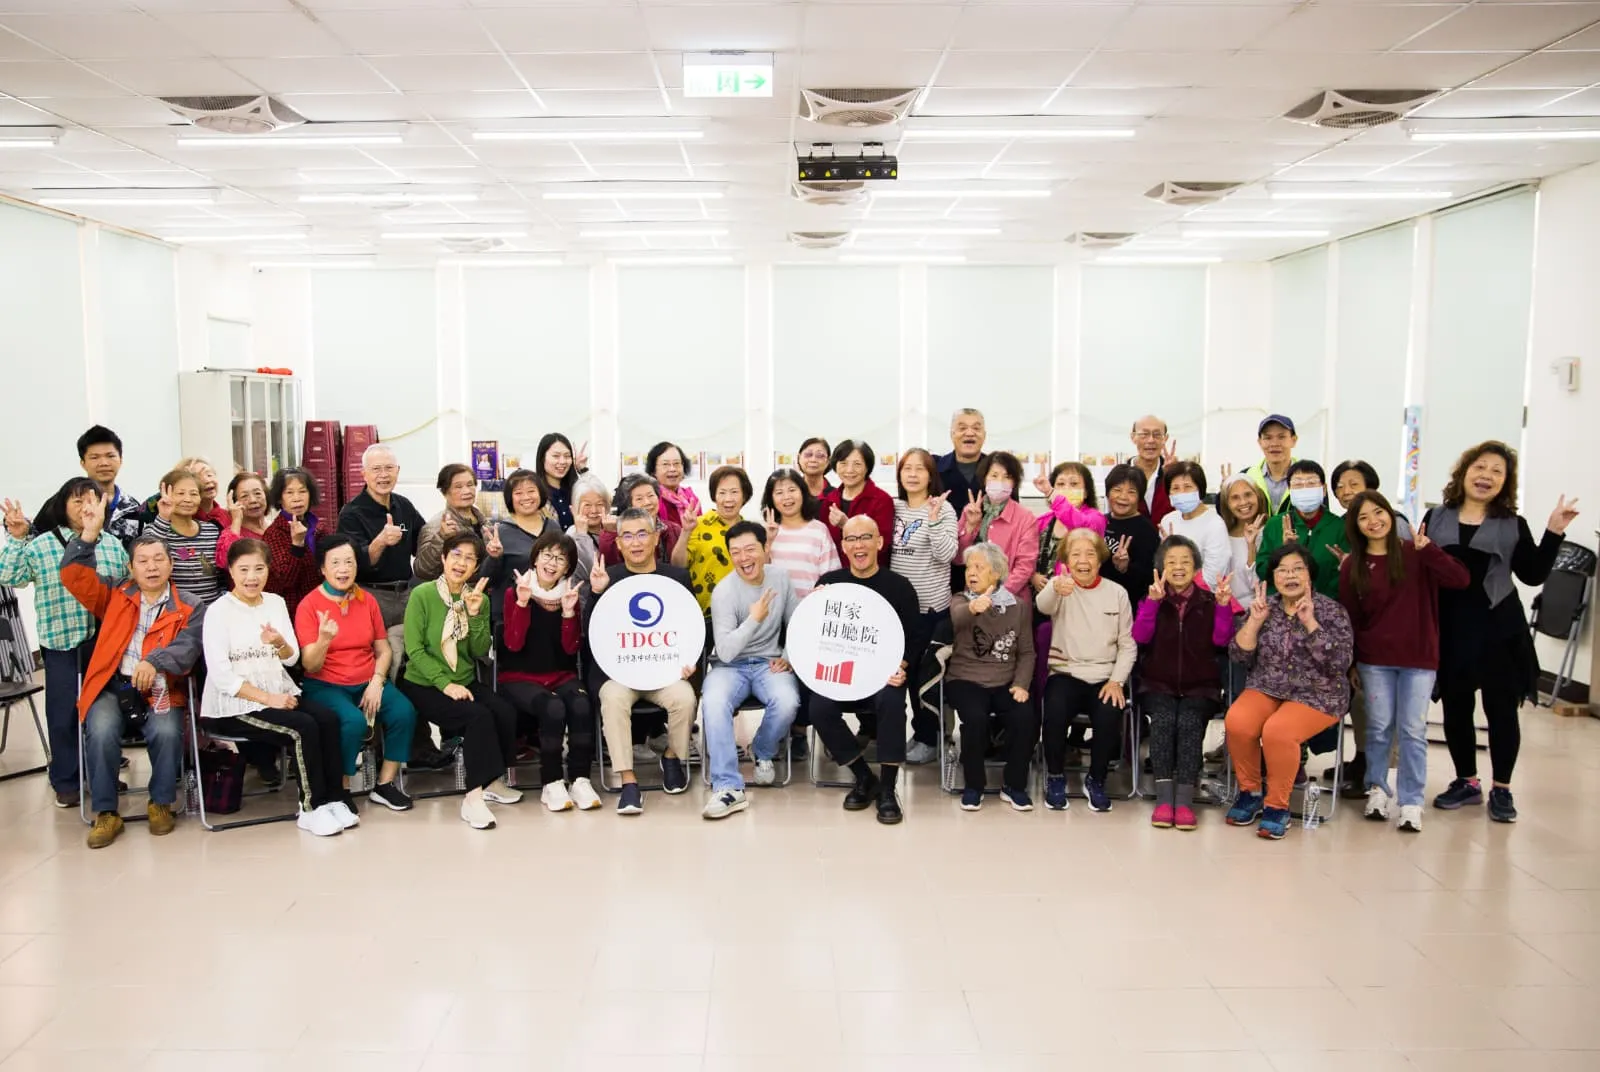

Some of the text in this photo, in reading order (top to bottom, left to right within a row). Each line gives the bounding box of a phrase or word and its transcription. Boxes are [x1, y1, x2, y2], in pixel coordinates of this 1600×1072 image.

[824, 599, 862, 620] 國家
[616, 631, 677, 649] TDCC
[821, 620, 879, 645] 兩廳院
